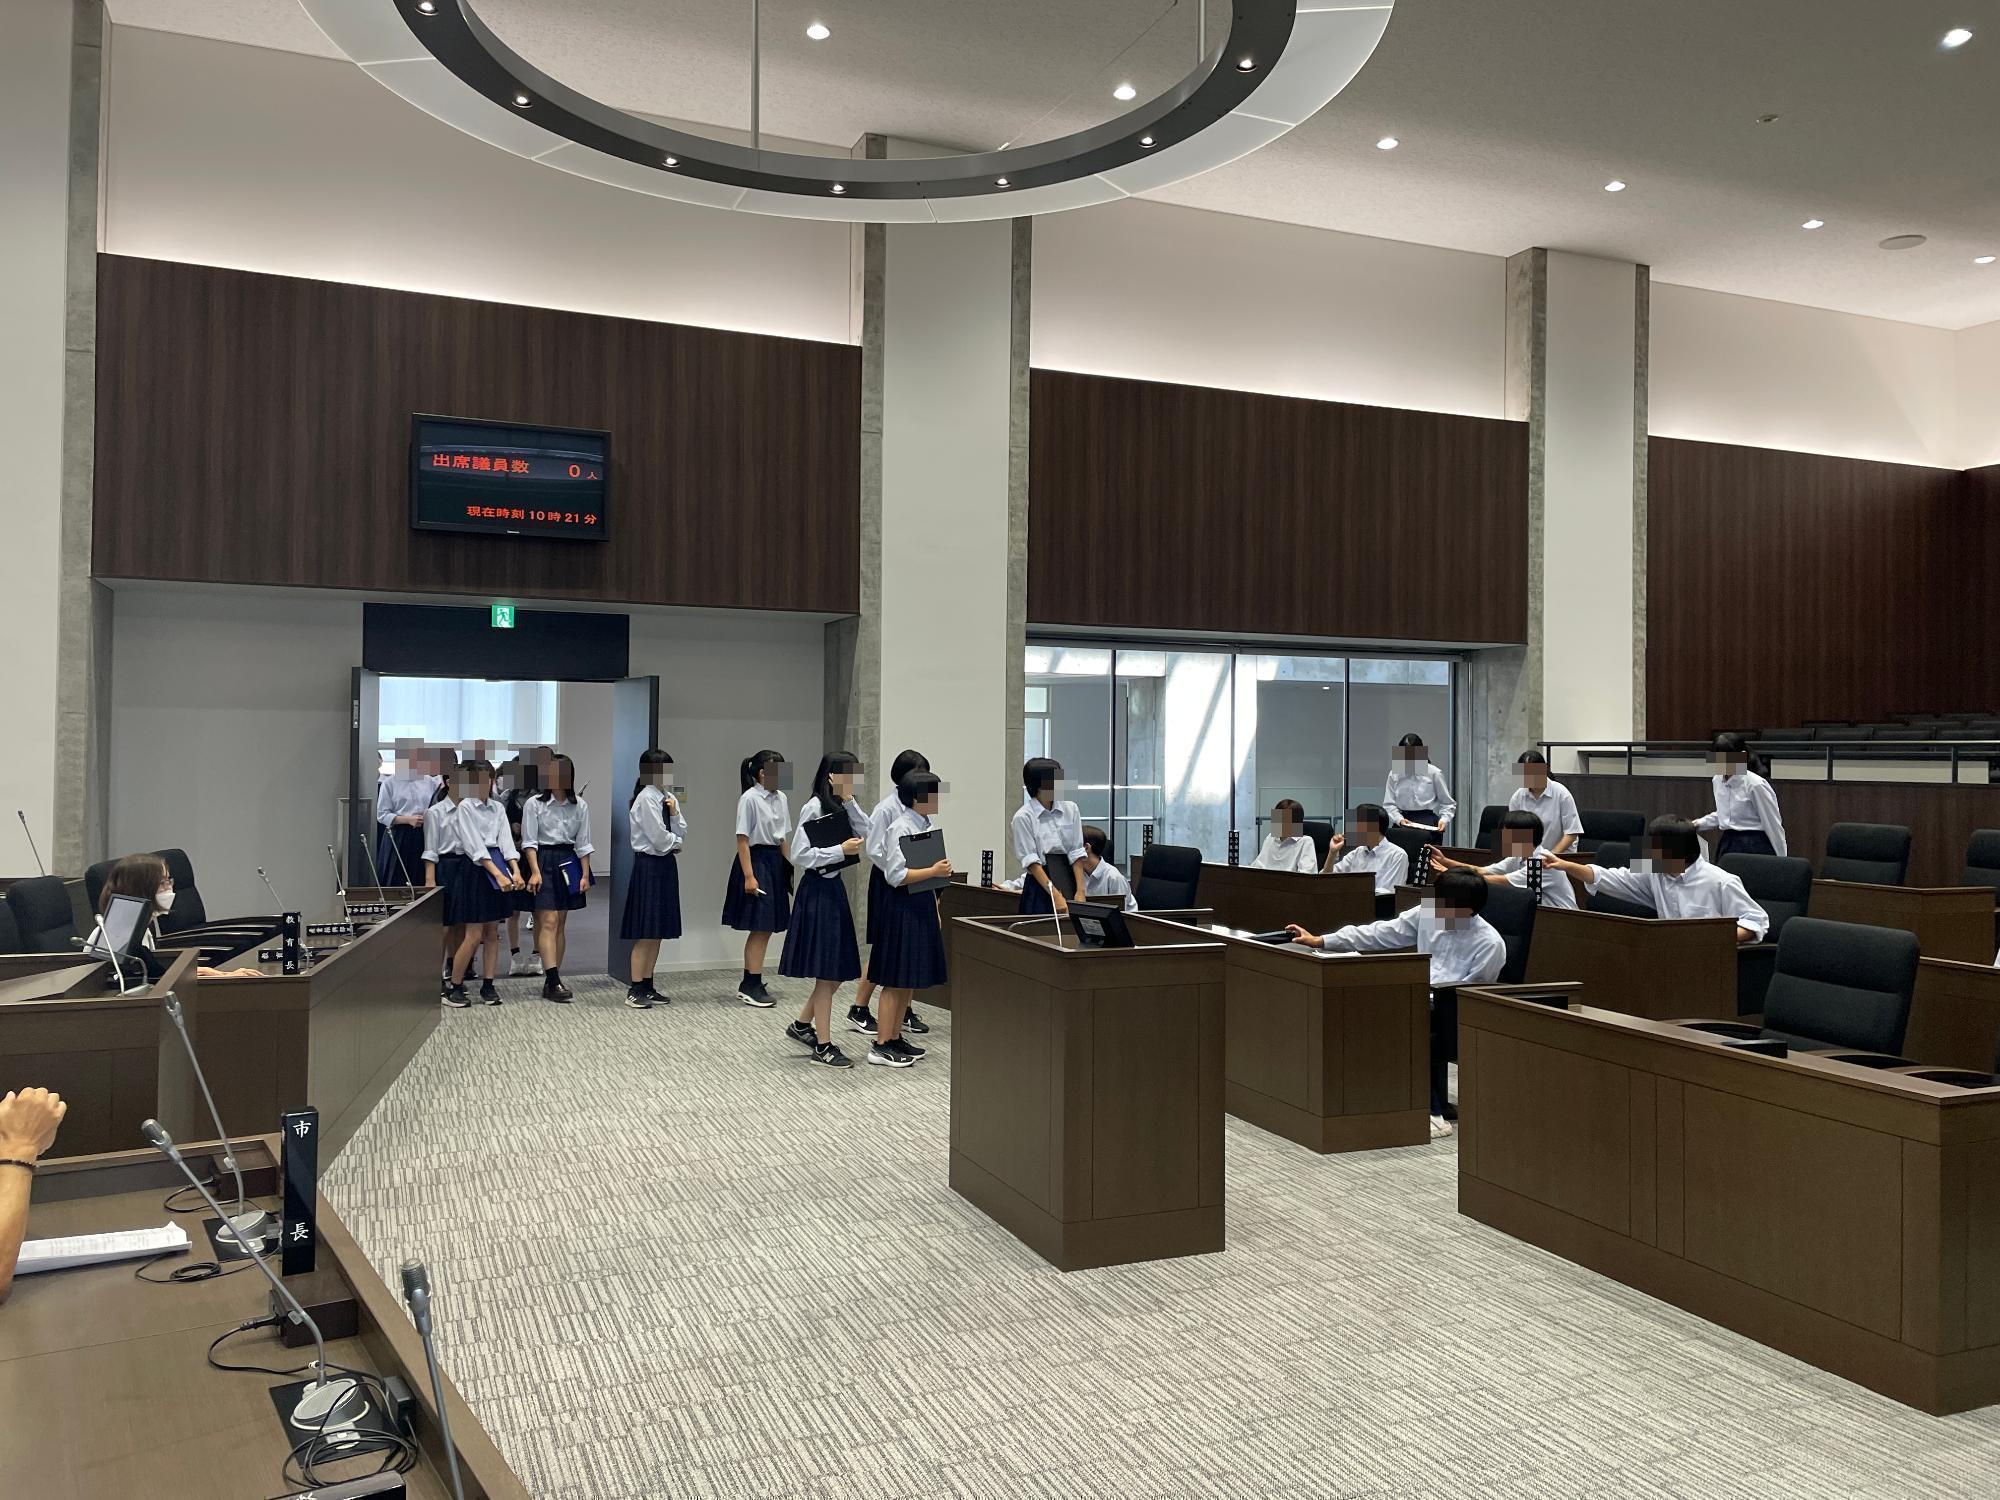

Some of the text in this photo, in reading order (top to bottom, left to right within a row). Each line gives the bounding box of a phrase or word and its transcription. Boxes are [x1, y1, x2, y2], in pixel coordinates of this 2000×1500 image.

[432, 453, 530, 474] 出席議員数
[285, 915, 295, 970] 教育長
[822, 1052, 835, 1063] N
[290, 1120, 312, 1242] 市長
